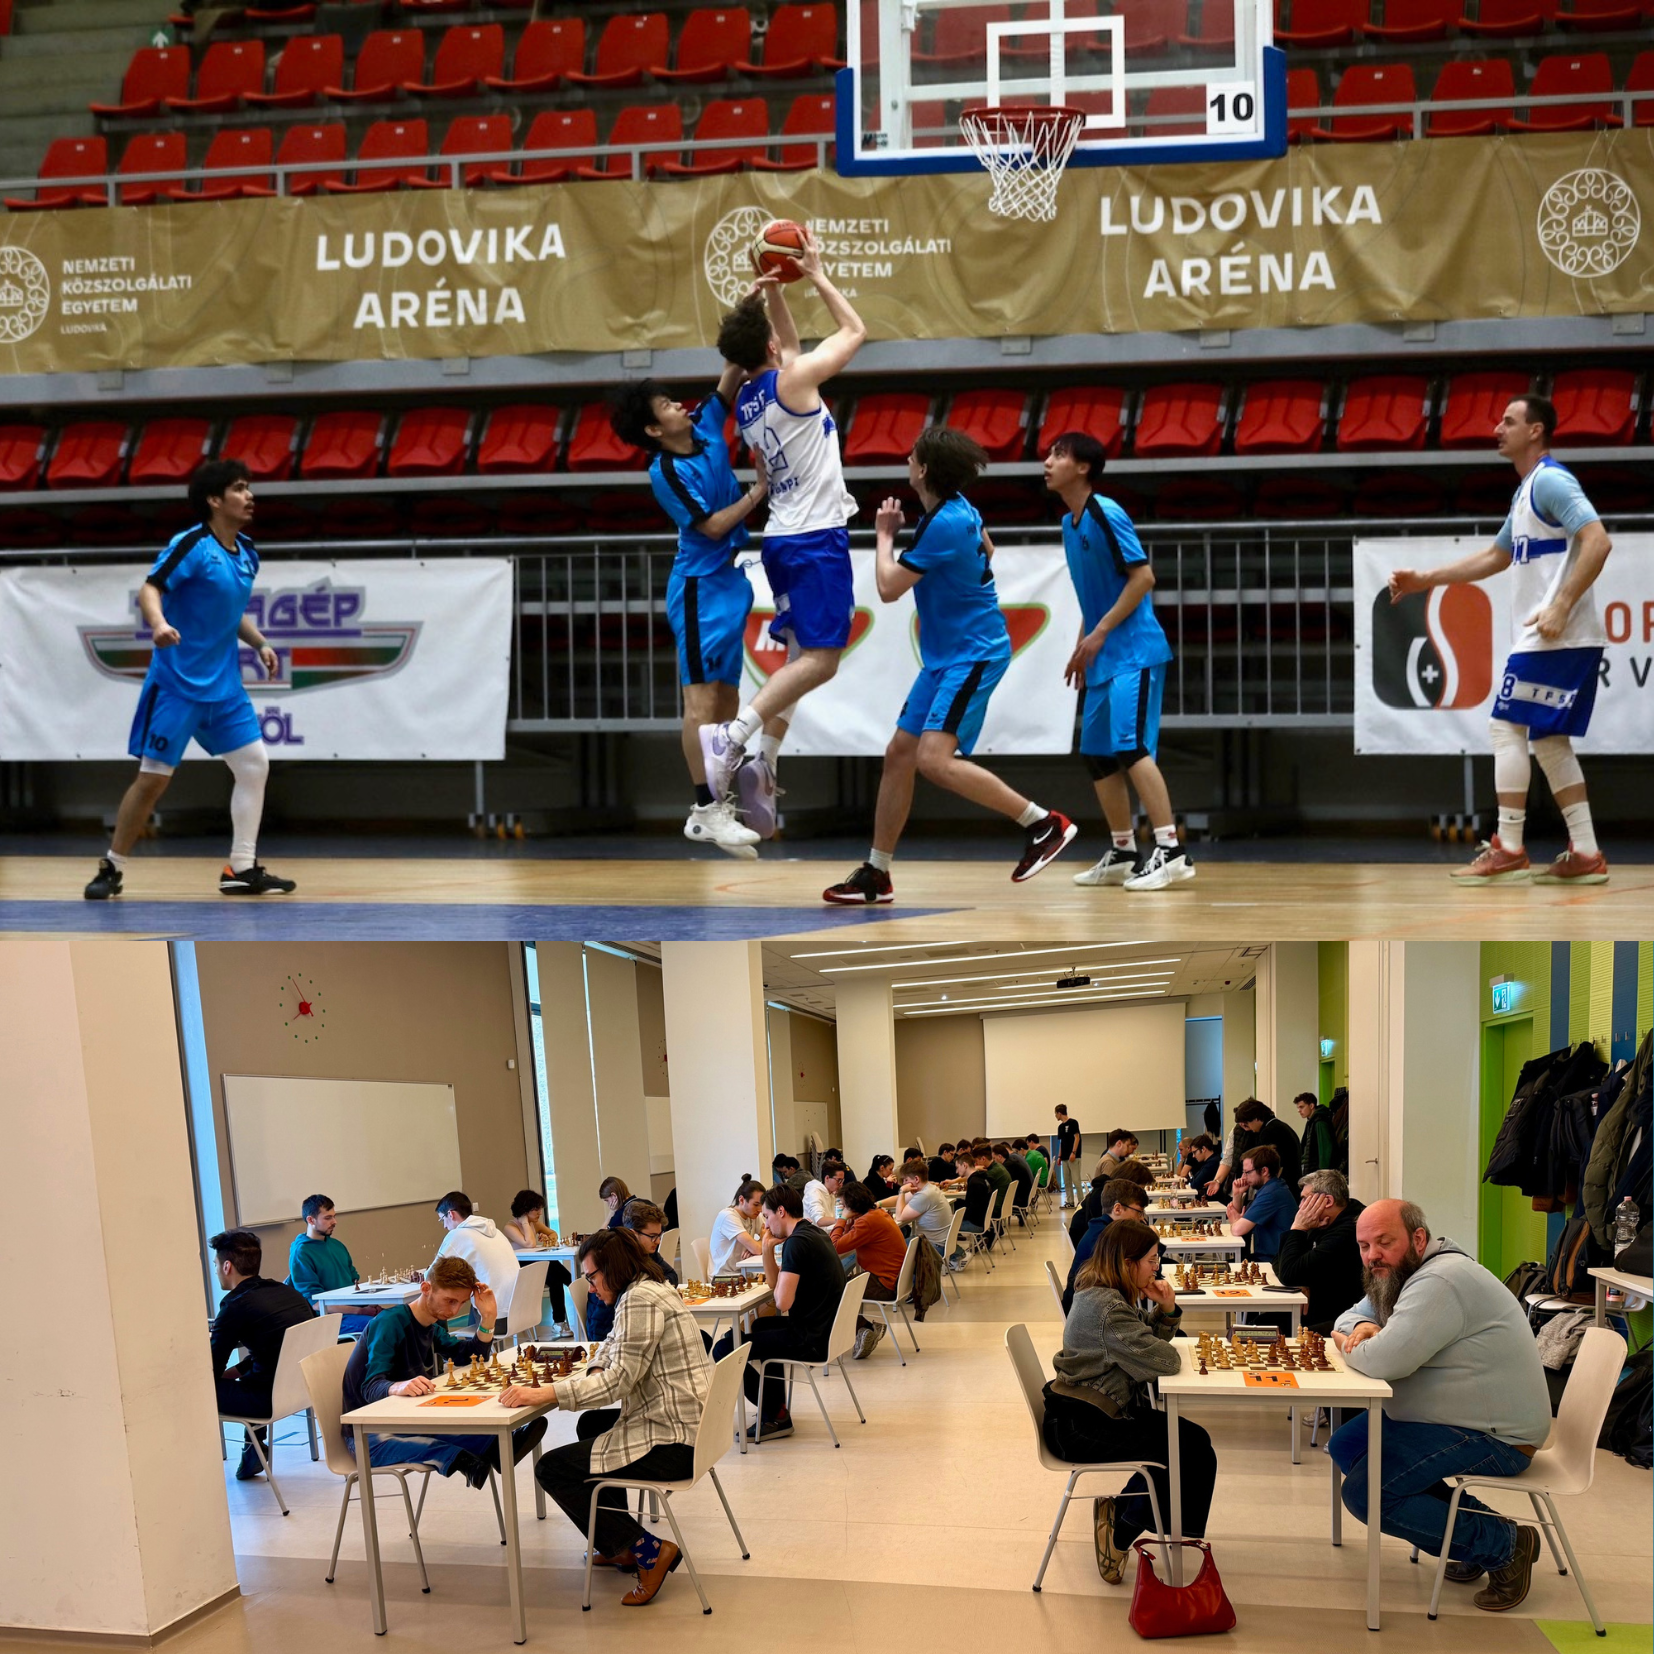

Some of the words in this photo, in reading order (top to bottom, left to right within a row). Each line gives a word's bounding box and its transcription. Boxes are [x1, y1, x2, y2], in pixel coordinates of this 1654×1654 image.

[1209, 92, 1255, 123] 10
[1100, 185, 1382, 235] LUDOVIKA
[316, 223, 566, 271] LUDOVIKA
[814, 235, 952, 255] ÖZSZOLGÁLATI
[62, 257, 135, 274] NEMZETI
[822, 262, 893, 277] YETEM
[1143, 241, 1336, 298] ARÉNA
[61, 273, 192, 294] KÖZSZOLGÁLATI
[61, 298, 138, 315] EGYETEM
[353, 277, 526, 329] ARÉNA
[150, 734, 168, 751] 10
